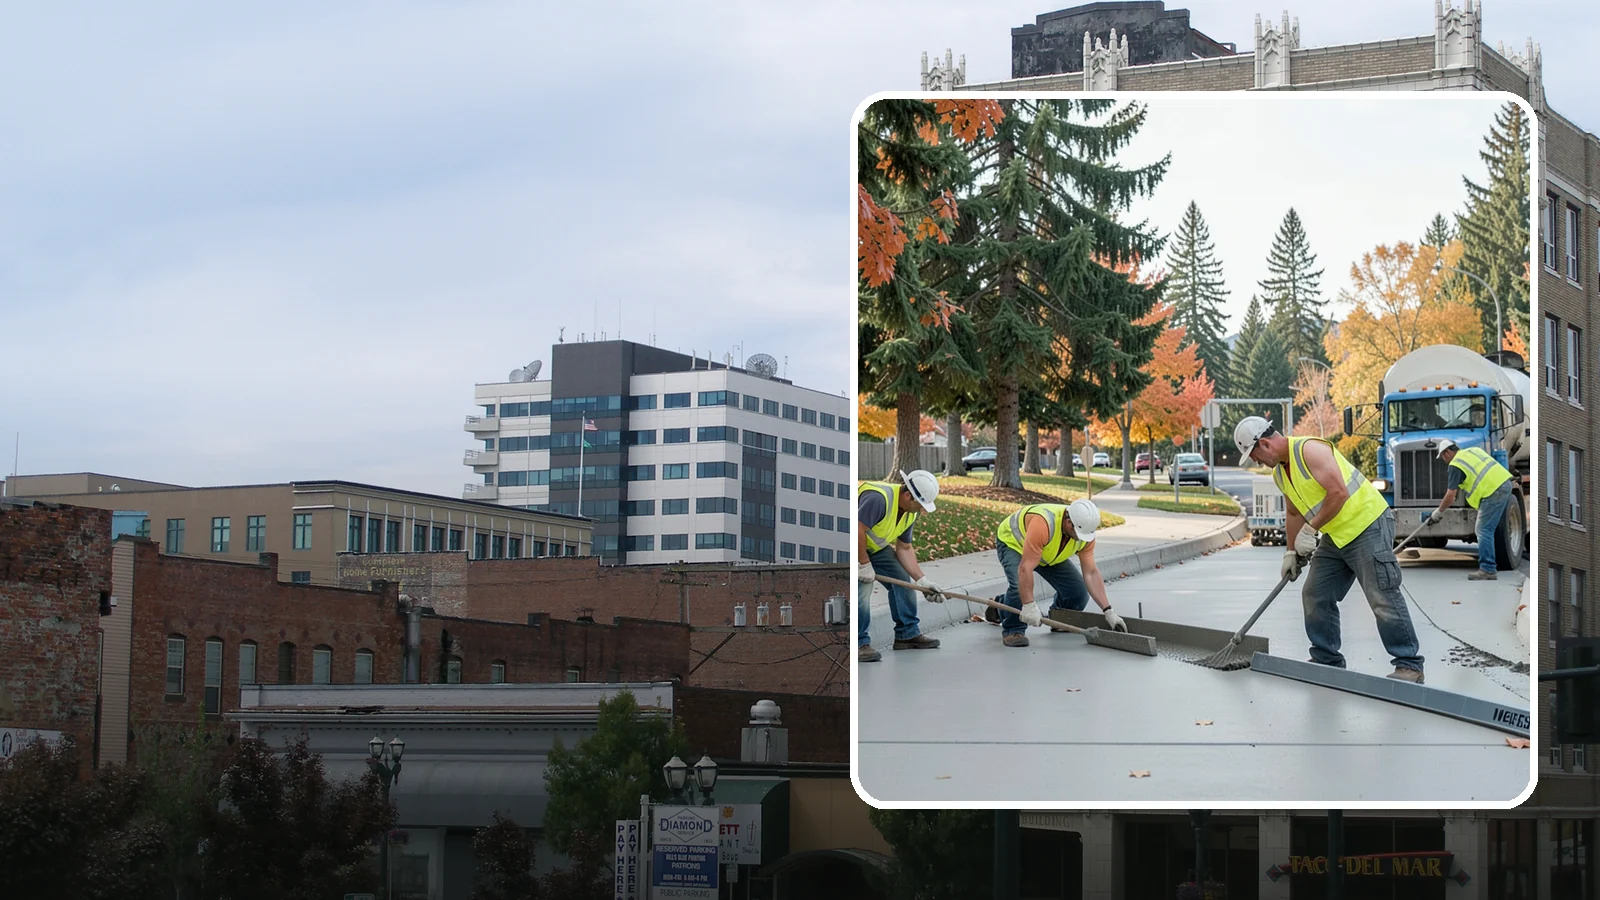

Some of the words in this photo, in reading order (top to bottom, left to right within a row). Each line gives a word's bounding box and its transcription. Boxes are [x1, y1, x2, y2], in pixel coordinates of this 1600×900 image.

[343, 568, 368, 577] Home
[370, 566, 427, 577] Furnishers
[660, 818, 713, 833] DIAMOND
[1022, 815, 1070, 828] BUILDING
[655, 845, 688, 853] RESERVED
[721, 852, 739, 862] Soup
[671, 862, 701, 870] PATRONS
[1346, 856, 1385, 876] DEL
[1392, 857, 1442, 878] MAR
[660, 888, 681, 897] PUBLIC
[683, 890, 710, 898] PARKING
